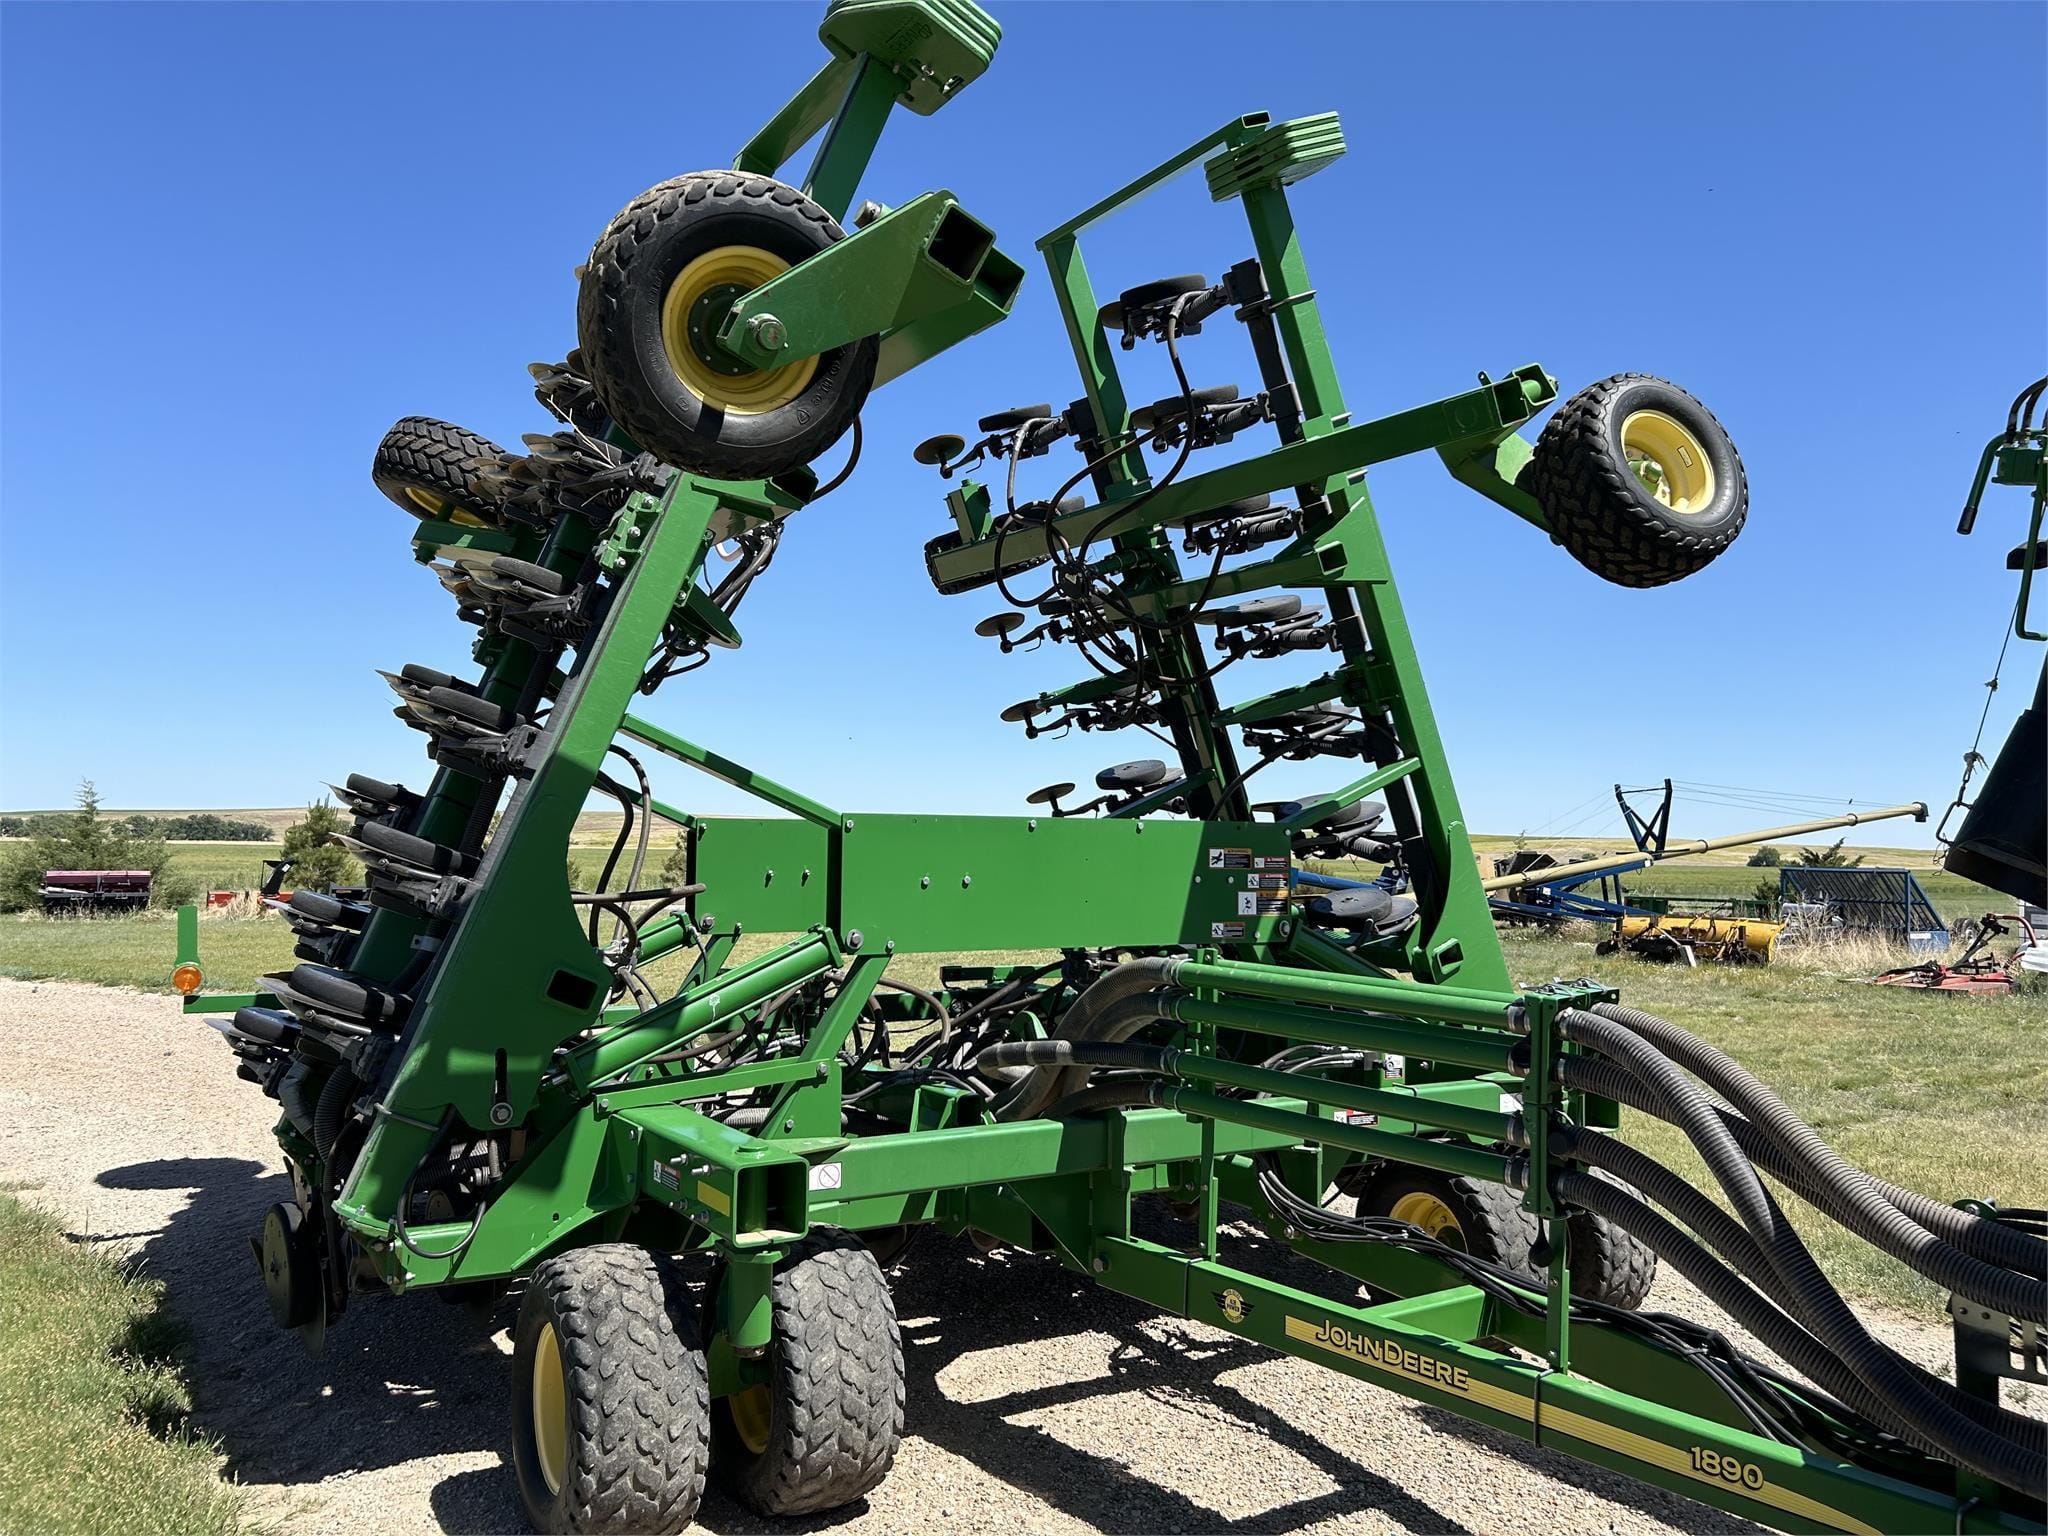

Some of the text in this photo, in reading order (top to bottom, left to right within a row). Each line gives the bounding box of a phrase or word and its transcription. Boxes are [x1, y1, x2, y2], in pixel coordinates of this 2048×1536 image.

[1316, 1319, 1470, 1391] JOHN DEERE
[1690, 1445, 1764, 1491] 1890
